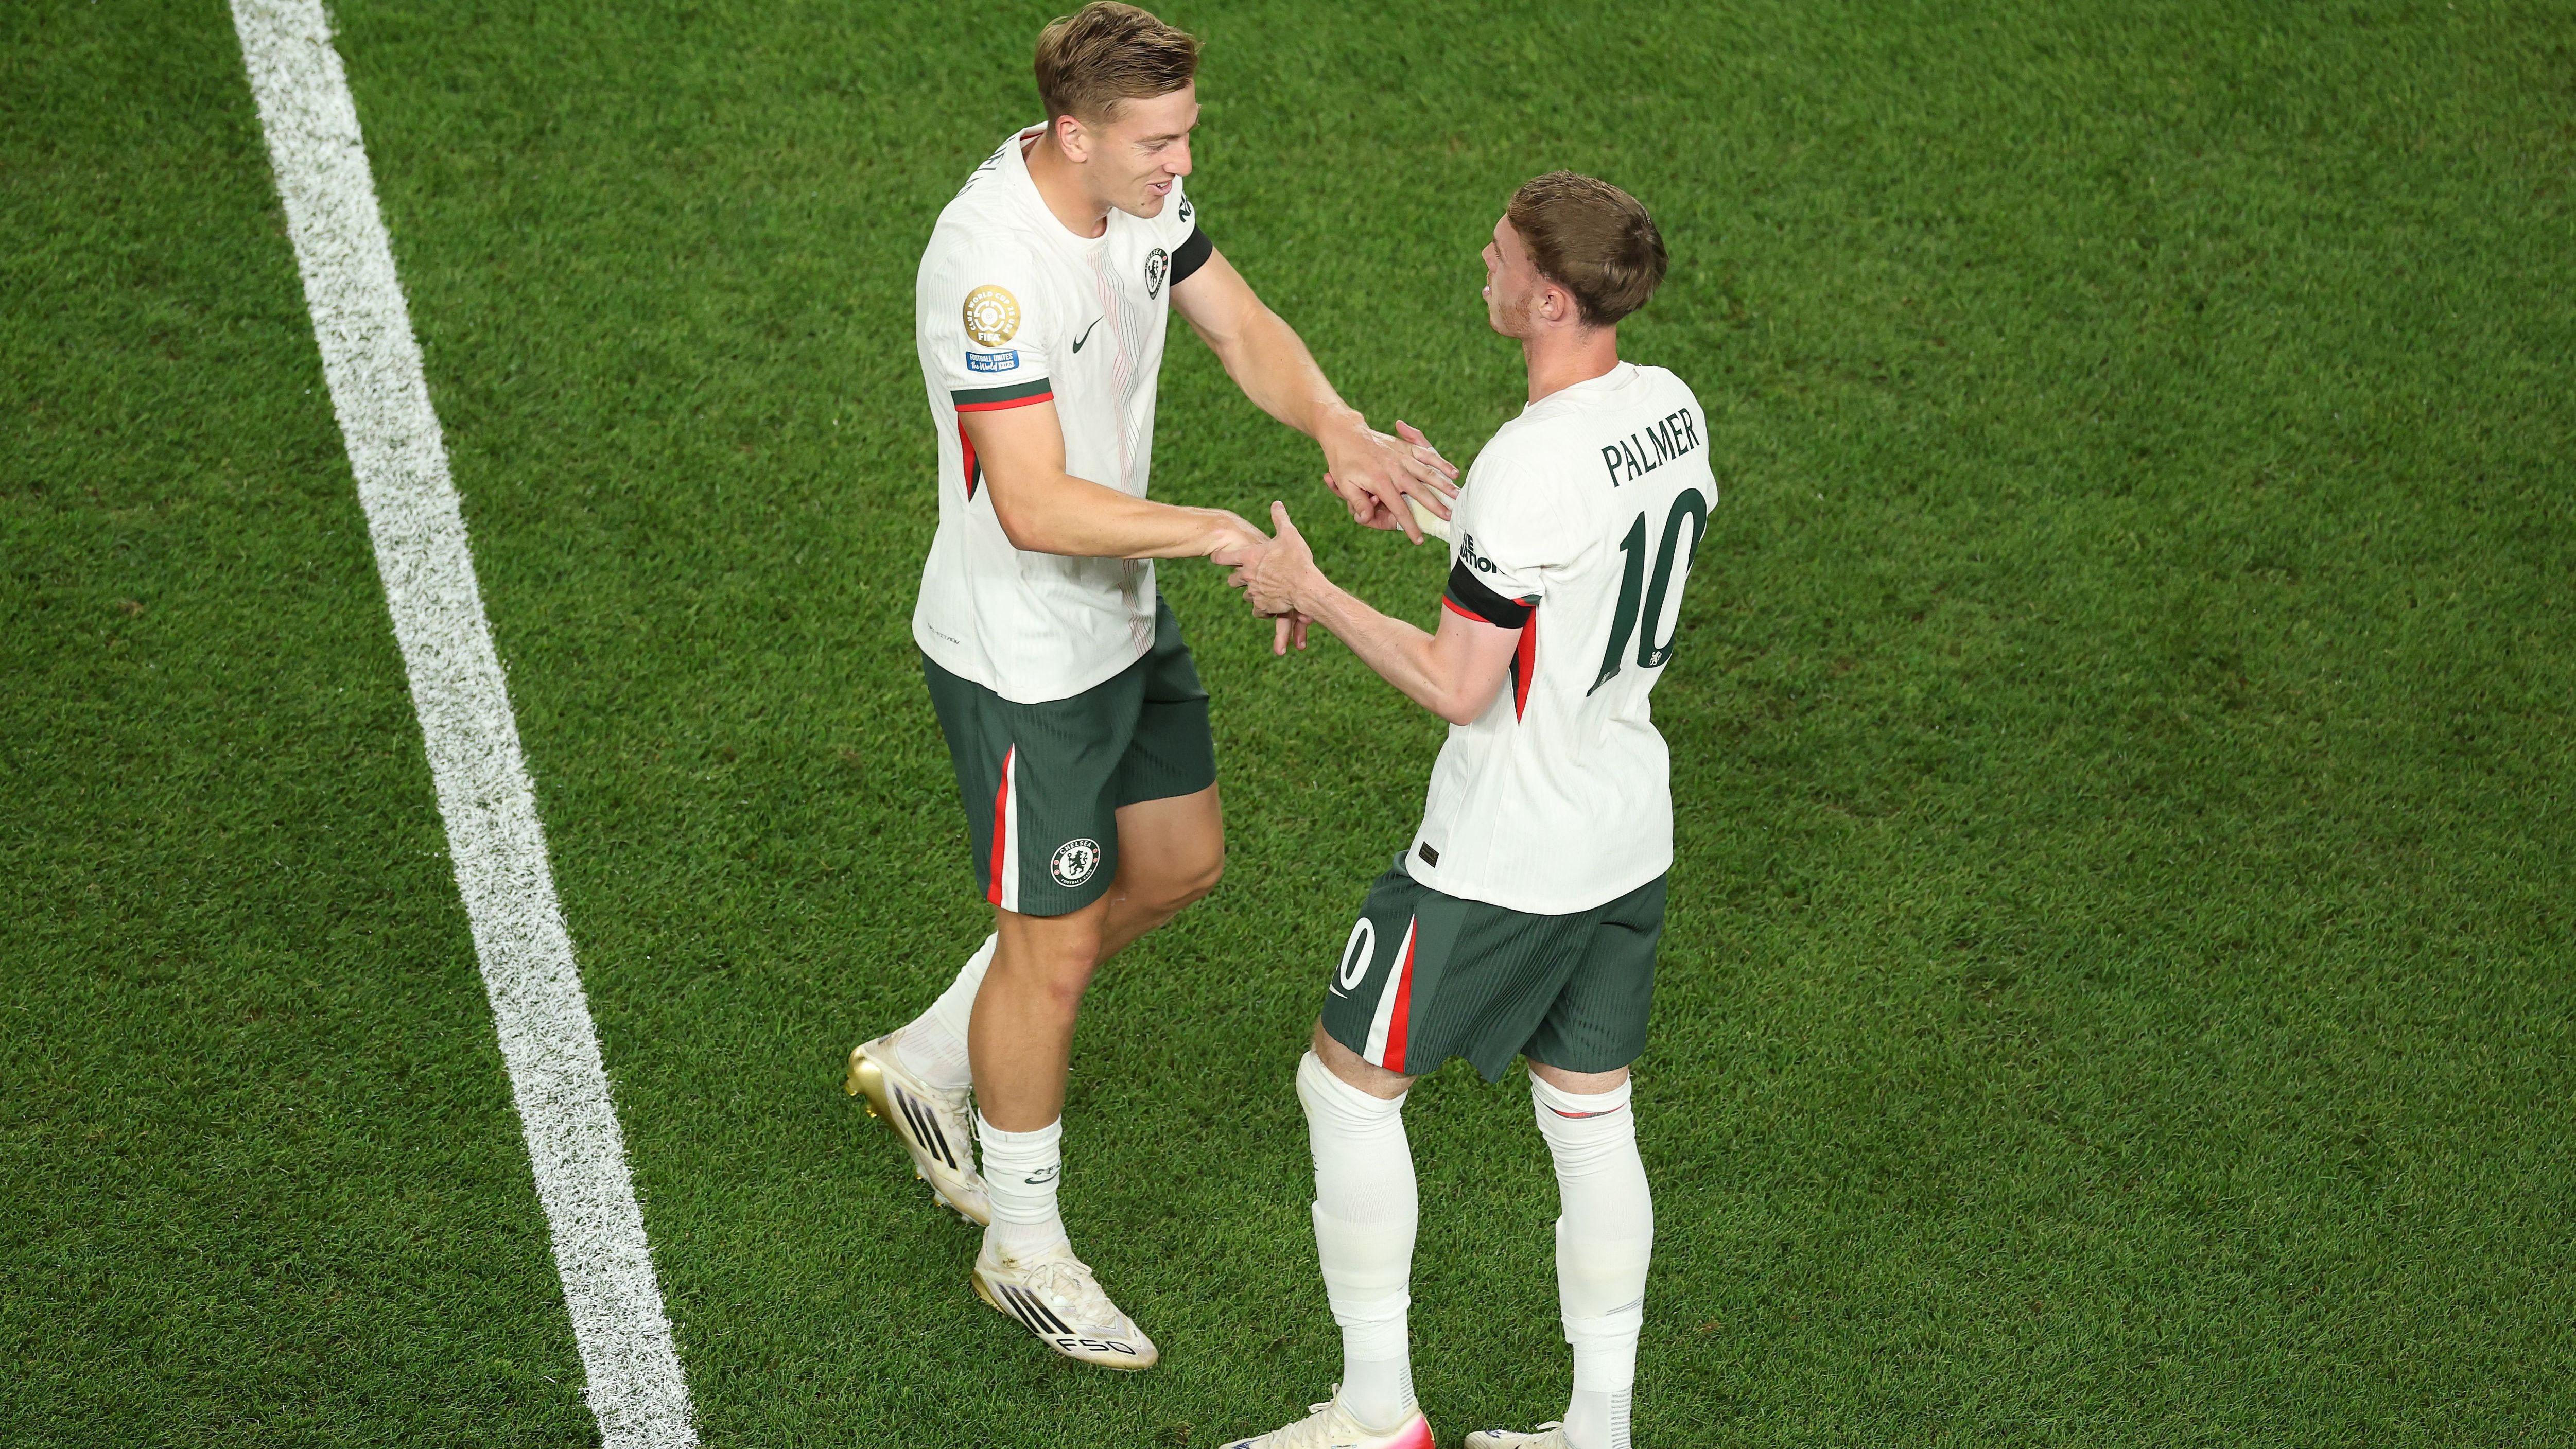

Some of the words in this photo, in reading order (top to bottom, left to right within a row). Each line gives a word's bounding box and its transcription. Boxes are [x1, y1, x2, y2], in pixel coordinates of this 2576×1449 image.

[968, 291, 993, 308] WORLD
[995, 293, 1011, 305] CUP
[967, 311, 976, 331] CLUB
[1003, 319, 1015, 334] USA
[978, 333, 1000, 342] FIFA
[969, 354, 993, 362] FOOTBALL
[994, 353, 1013, 361] UNITES
[979, 362, 997, 371] World
[1601, 408, 1700, 487] PALMER
[1586, 488, 1707, 697] 10
[1059, 841, 1092, 854] CHELSEA
[1083, 869, 1092, 879] CLUB
[1333, 917, 1376, 990] 0
[1056, 1339, 1136, 1355] F50
